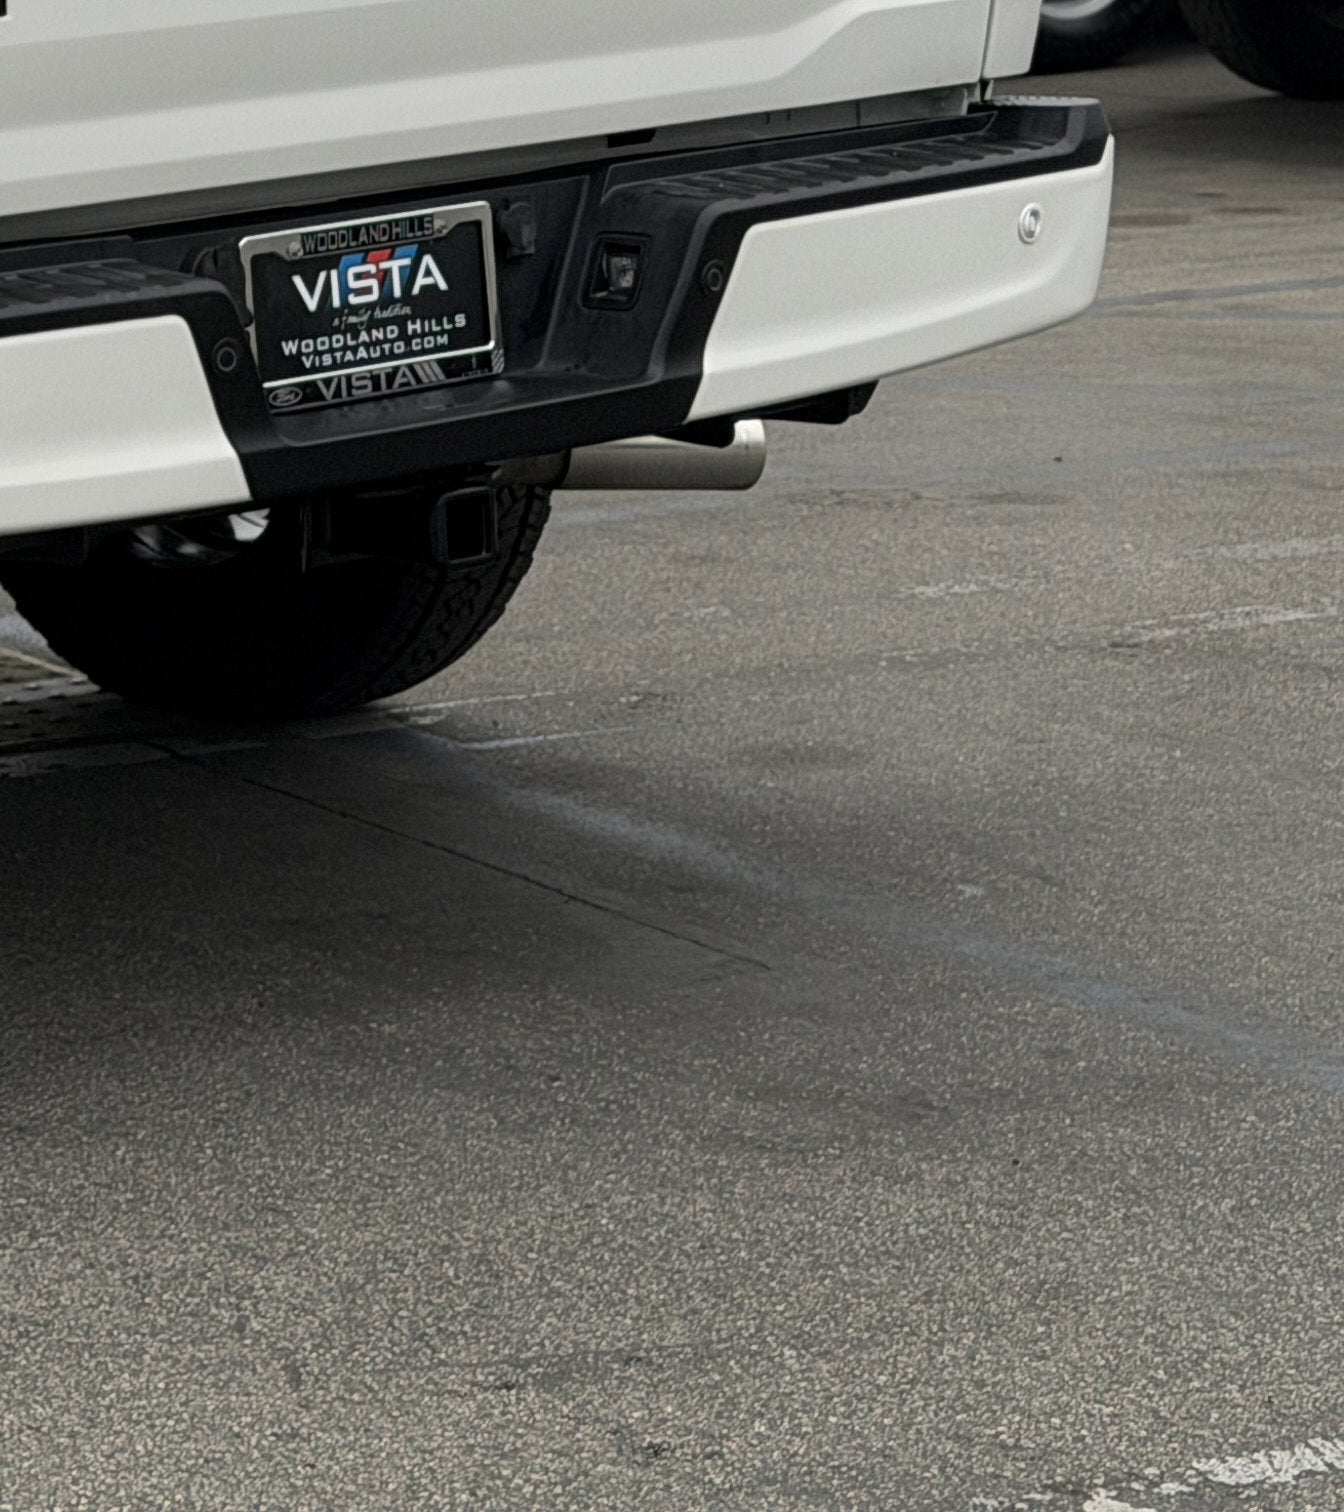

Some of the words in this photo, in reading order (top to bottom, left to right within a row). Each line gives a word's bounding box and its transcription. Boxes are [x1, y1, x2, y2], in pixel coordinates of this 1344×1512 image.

[303, 224, 391, 253] WOODLAND
[391, 216, 434, 241] HILLS
[292, 255, 448, 312] VISTA
[281, 324, 400, 356] WOODLAND
[407, 313, 468, 336] HILLS
[318, 367, 418, 400] VISTA
